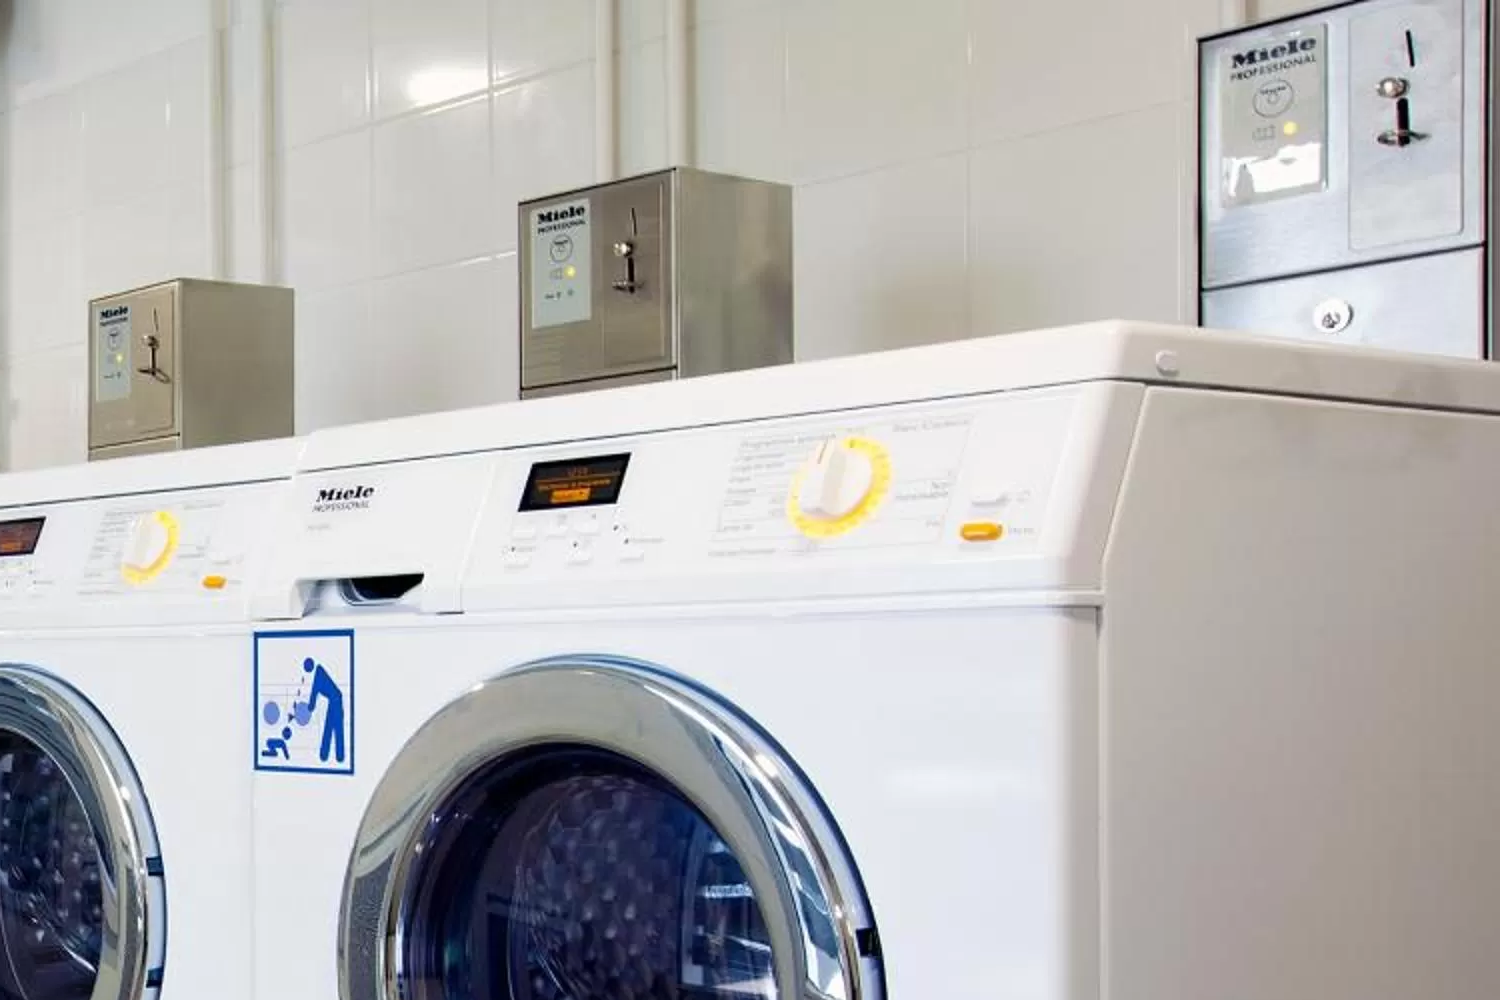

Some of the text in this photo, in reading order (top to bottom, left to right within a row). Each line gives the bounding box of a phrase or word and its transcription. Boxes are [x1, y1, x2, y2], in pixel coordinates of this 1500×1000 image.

[1231, 37, 1316, 69] Miele
[1230, 54, 1316, 81] PROFESSIONAL
[537, 206, 585, 224] Miele
[315, 485, 375, 502] Miele
